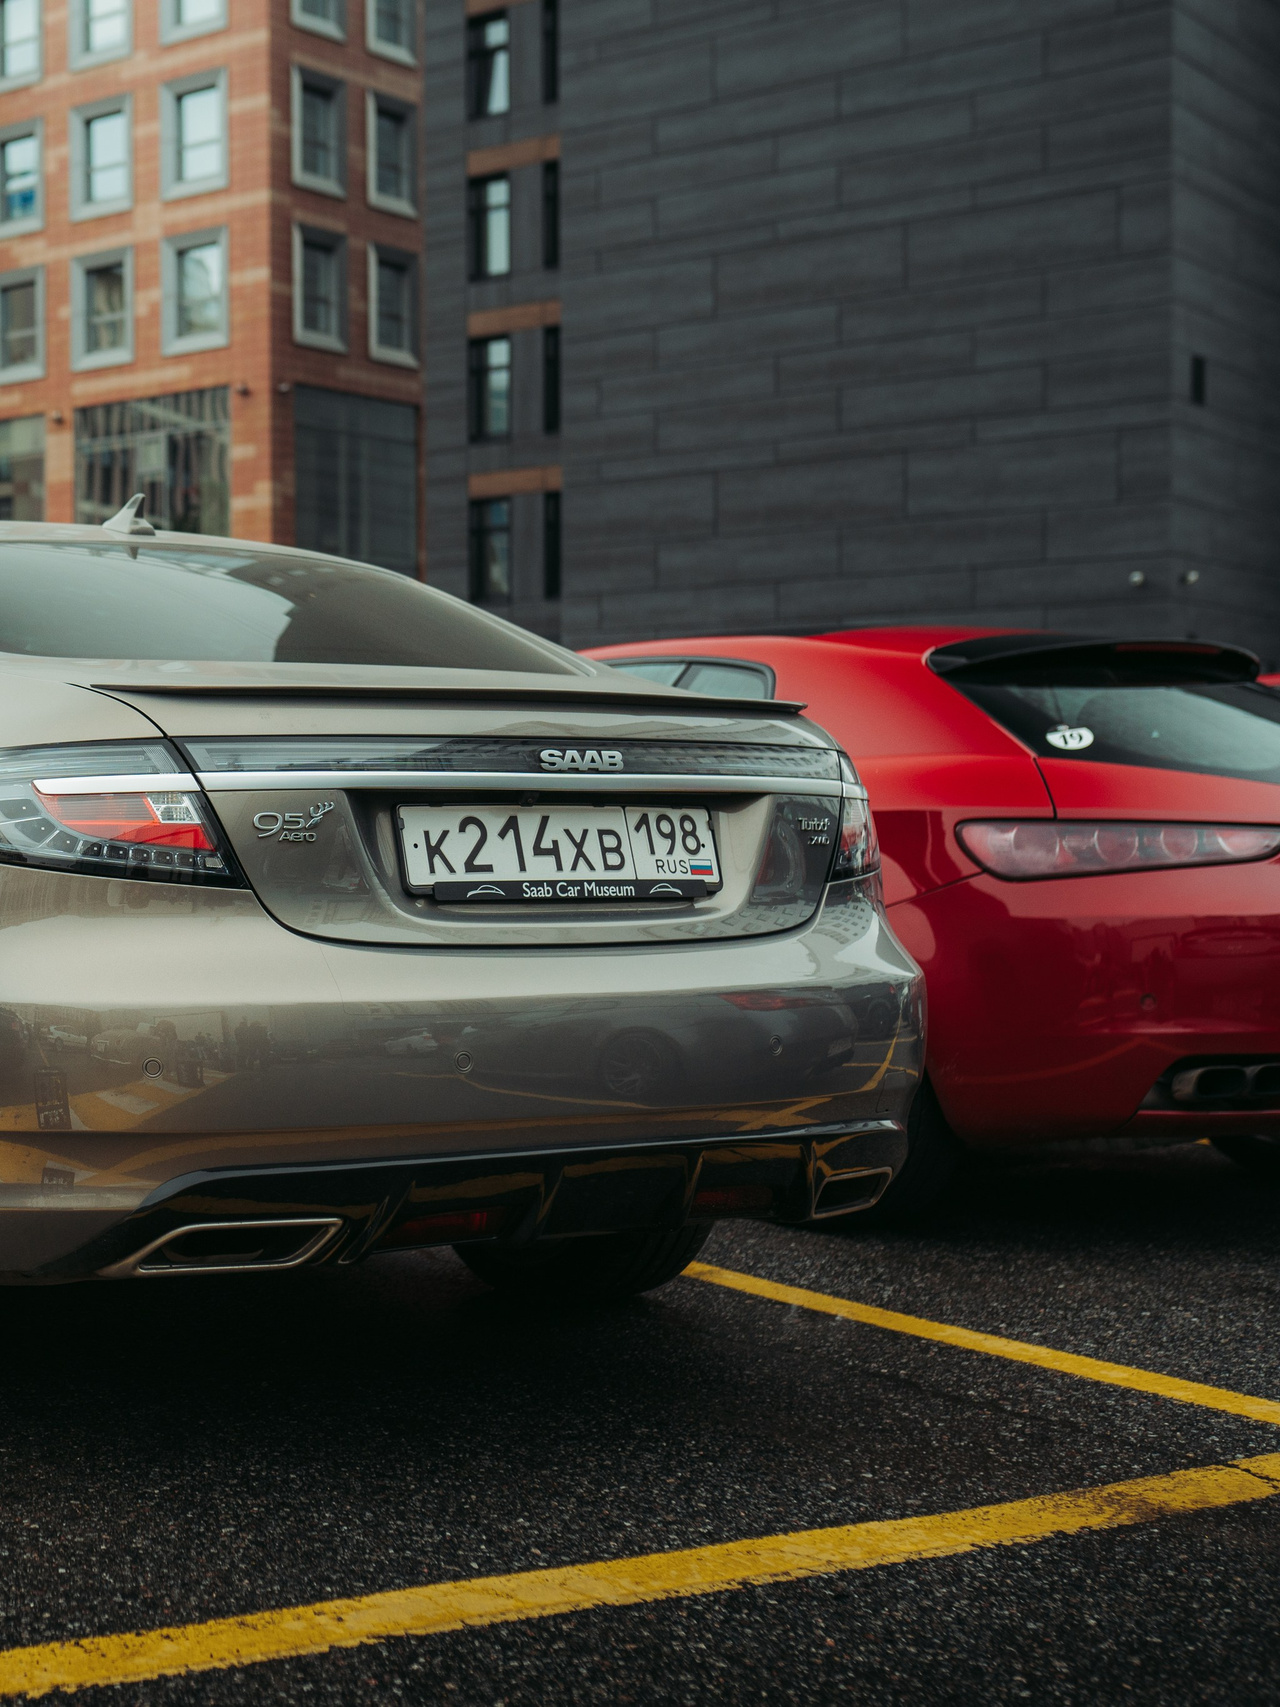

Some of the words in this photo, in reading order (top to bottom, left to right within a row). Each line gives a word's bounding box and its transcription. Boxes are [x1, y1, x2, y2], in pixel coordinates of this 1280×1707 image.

[1061, 731, 1084, 746] 19
[540, 749, 624, 772] SAAB
[278, 831, 317, 842] Aero
[423, 814, 626, 876] К214ХВ
[634, 813, 701, 855] 198
[655, 858, 689, 875] RUS
[522, 883, 552, 898] Saab
[556, 883, 580, 898] Car
[584, 883, 635, 898] Museum
